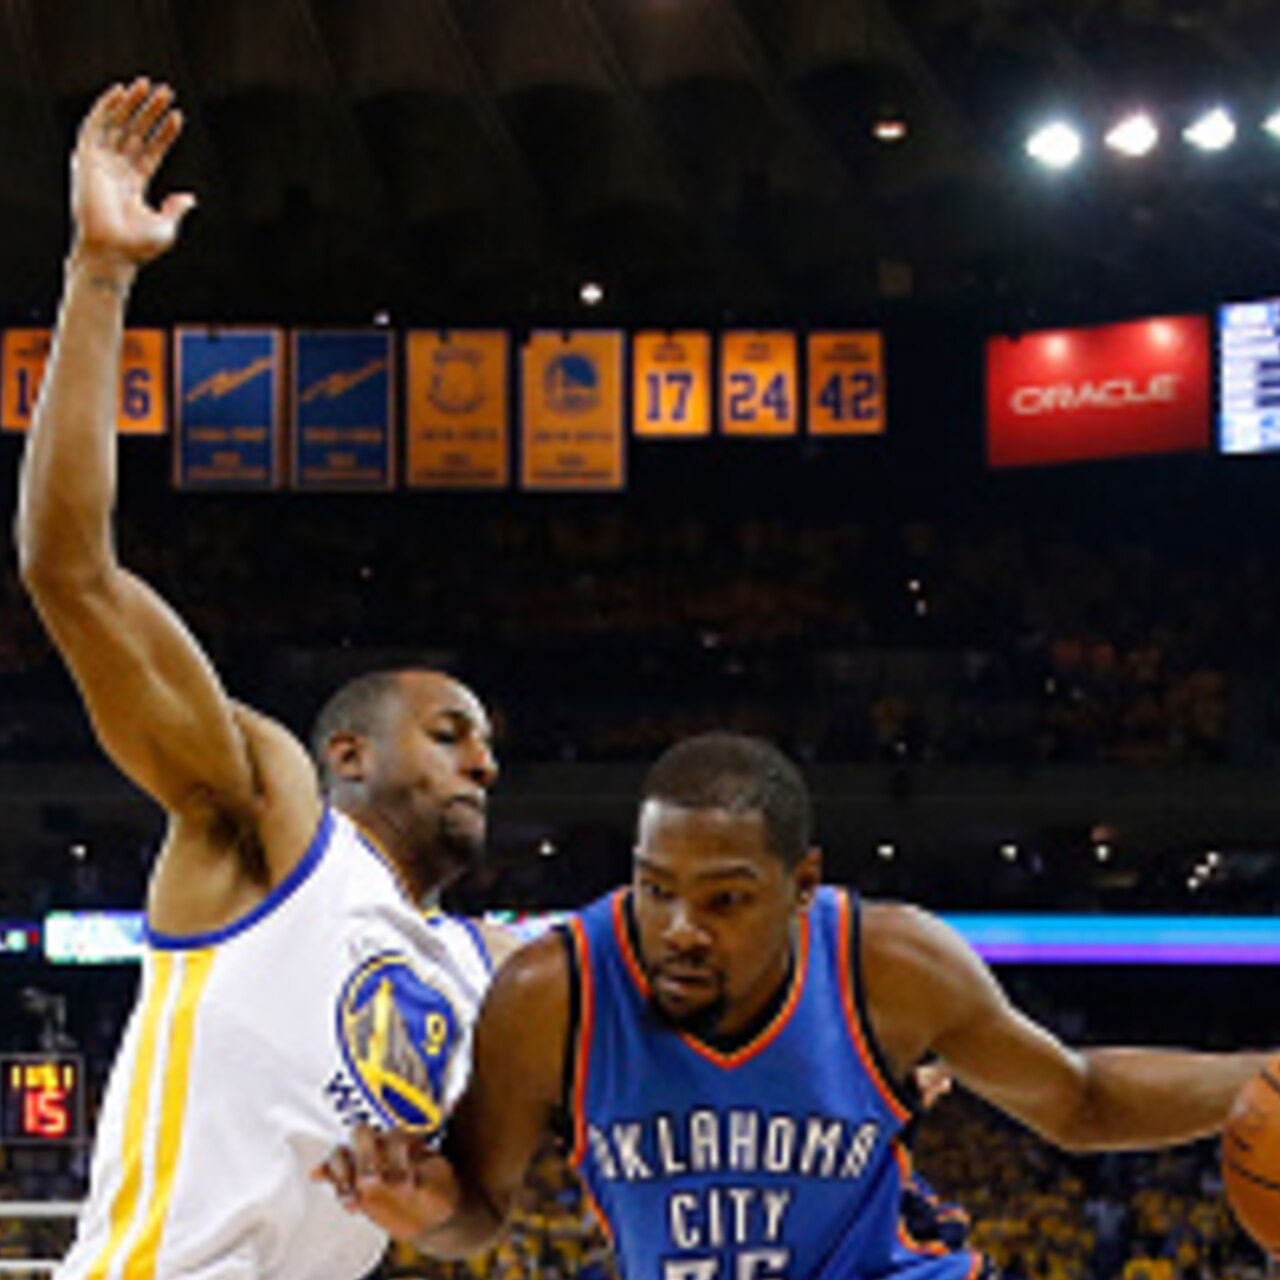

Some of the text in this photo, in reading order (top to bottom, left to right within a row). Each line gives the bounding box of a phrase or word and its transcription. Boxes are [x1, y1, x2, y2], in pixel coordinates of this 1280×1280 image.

[646, 372, 693, 422] 17
[729, 372, 789, 422] 24
[820, 372, 880, 421] 42
[1008, 372, 1184, 415] ORACLE
[25, 1090, 67, 1136] 15
[670, 1188, 791, 1249] CITY
